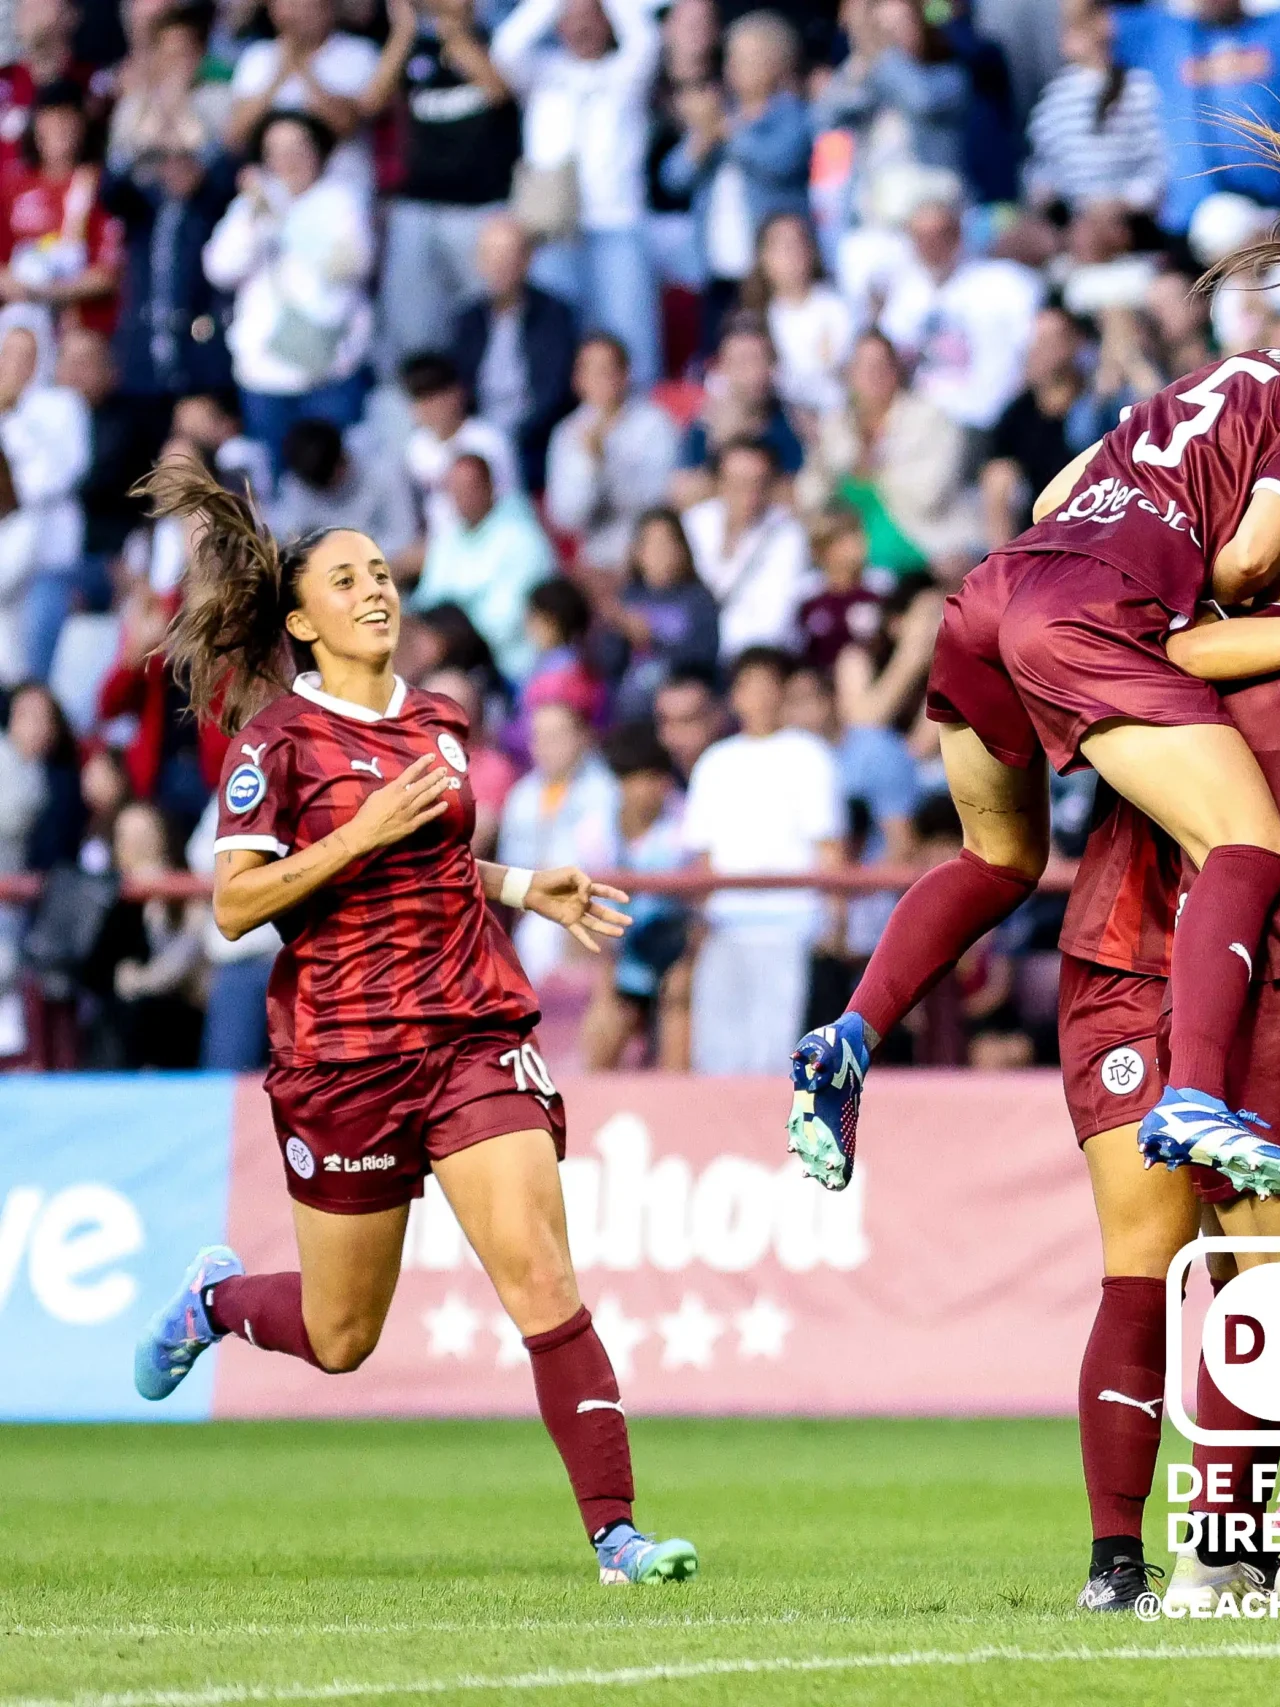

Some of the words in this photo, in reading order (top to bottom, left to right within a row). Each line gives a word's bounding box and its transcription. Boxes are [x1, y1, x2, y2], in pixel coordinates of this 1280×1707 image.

[1132, 356, 1280, 468] 5
[499, 1043, 557, 1097] 70
[344, 1157, 361, 1172] La
[362, 1153, 395, 1171] Rioja
